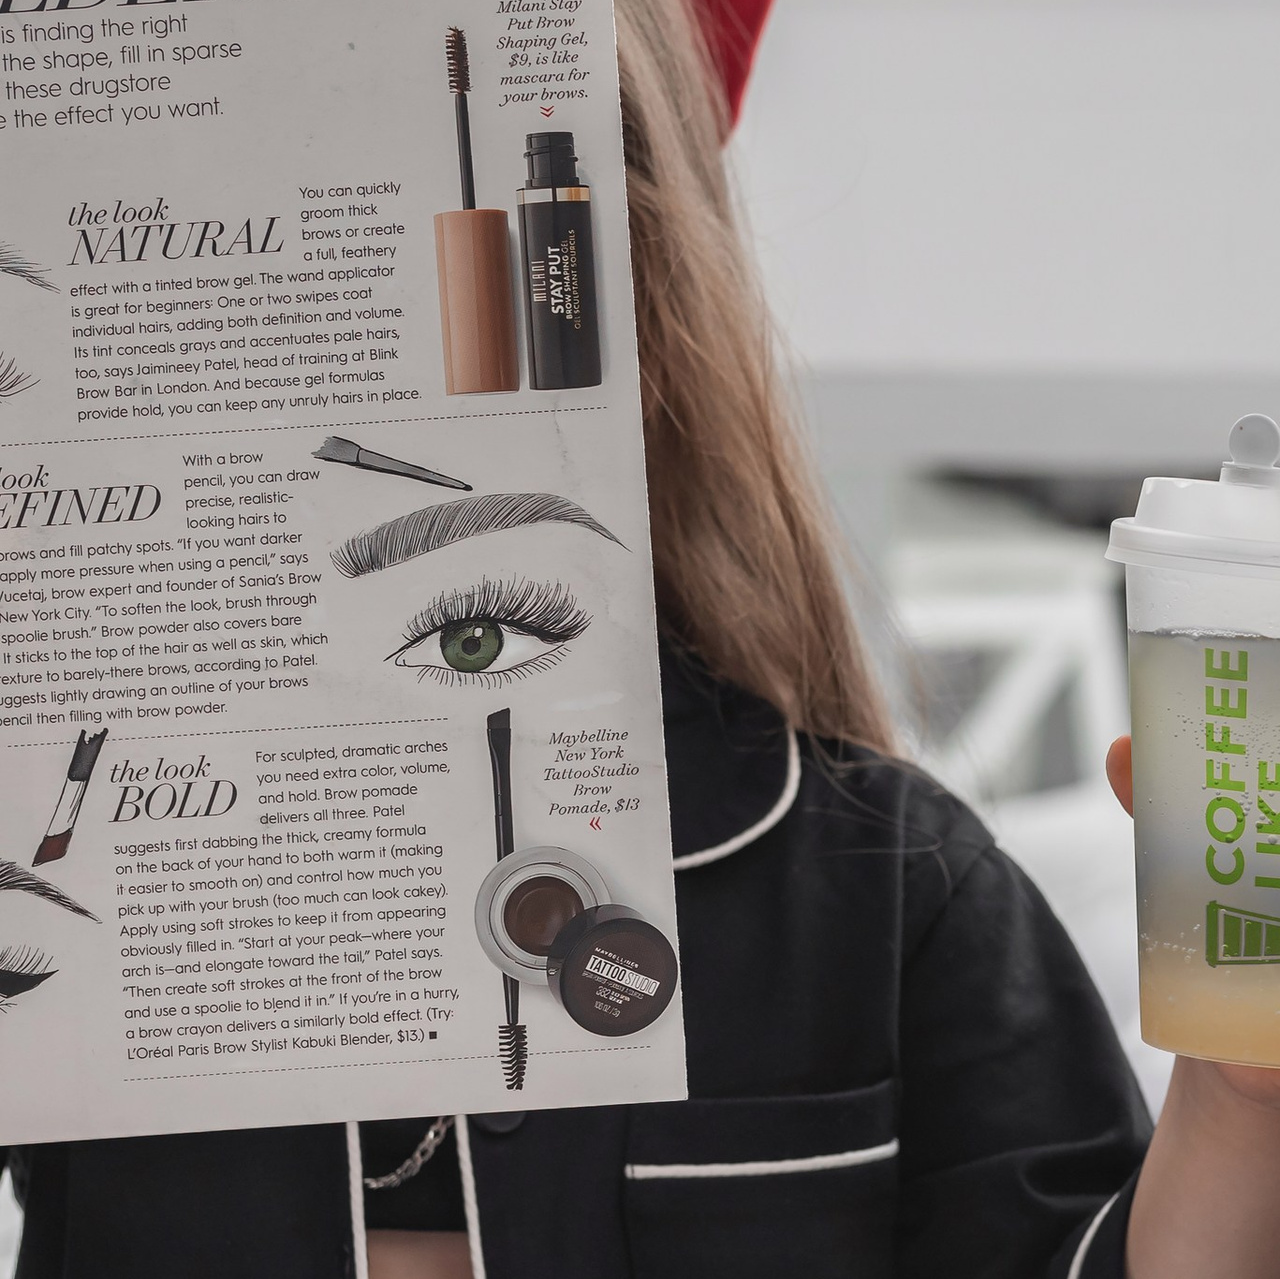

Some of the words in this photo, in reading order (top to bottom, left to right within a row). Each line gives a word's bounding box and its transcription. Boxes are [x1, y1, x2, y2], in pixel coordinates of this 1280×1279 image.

[0, 26, 15, 43] is
[22, 22, 93, 43] finding
[101, 18, 134, 37] the
[142, 13, 187, 38] right
[507, 18, 533, 30] Put
[536, 16, 574, 28] Brow
[496, 34, 556, 51] Shaping
[561, 31, 587, 46] Gel,
[2, 53, 35, 71] the
[43, 50, 112, 71] shape,
[120, 45, 139, 63] fill
[147, 45, 164, 61] in
[172, 43, 241, 64] sparse
[508, 53, 531, 67] $9,
[536, 52, 548, 64] is
[552, 50, 578, 63] like
[5, 81, 61, 99] these
[69, 73, 170, 98] drugstore
[500, 73, 564, 85] mascara
[568, 68, 589, 81] for
[498, 92, 537, 107] your
[540, 87, 587, 100] brows.
[14, 109, 47, 128] the
[54, 103, 113, 125] effect
[121, 105, 160, 125] you
[167, 96, 223, 117] want.
[299, 187, 323, 198] You
[328, 187, 352, 197] can
[356, 181, 400, 197] quickly
[68, 200, 107, 226] the
[113, 197, 169, 223] look
[300, 208, 344, 222] groom
[348, 203, 377, 216] thick
[67, 216, 285, 266] NATURAL
[302, 229, 341, 240] brows
[345, 228, 359, 237] or
[363, 223, 404, 236] create
[303, 252, 312, 261] a
[316, 247, 337, 260] full,
[341, 245, 396, 258] feathery
[547, 246, 561, 275] PUT
[70, 283, 107, 296] effect
[111, 281, 138, 293] with
[142, 283, 151, 292] a
[155, 277, 192, 291] tinted
[196, 277, 229, 288] brow
[233, 273, 256, 289] gel.
[259, 272, 283, 284] The
[286, 269, 323, 282] wand
[328, 265, 395, 282] applicator
[562, 255, 572, 292] SHAPING
[549, 278, 564, 314] STAY
[564, 294, 573, 320] BROW
[182, 454, 212, 466] With
[216, 456, 225, 464] a
[229, 452, 263, 464] brow
[184, 474, 225, 490] pencil,
[229, 475, 253, 487] you
[258, 473, 282, 483] can
[287, 469, 320, 481] draw
[185, 495, 234, 511] precise,
[187, 515, 234, 529] looking
[238, 513, 269, 525] hairs
[273, 512, 286, 523] to
[549, 728, 628, 747] Maybelline
[256, 751, 276, 762] For
[280, 746, 337, 762] sculpted,
[342, 743, 400, 757] dramatic
[404, 741, 448, 753] arches
[554, 749, 585, 762] New
[590, 745, 623, 760] York
[110, 759, 148, 784] the
[154, 755, 210, 780] look
[256, 774, 280, 786] you
[285, 768, 318, 781] need
[323, 767, 356, 779] extra
[360, 764, 396, 777] color,
[400, 762, 450, 774] volume,
[544, 763, 639, 780] TattooStudio
[1204, 647, 1249, 886] COFFEE
[573, 784, 611, 795] Brow
[108, 779, 238, 823] BOLD
[549, 800, 610, 815] Pomade,
[614, 798, 639, 812] $13
[589, 956, 627, 982] TATTOO
[625, 971, 658, 995] STUDIO
[127, 1045, 173, 1059] L’Oréal
[178, 1043, 209, 1056] Paris
[214, 1042, 246, 1054] Brow
[251, 1038, 287, 1053] Stylist
[292, 1035, 335, 1048] Kabuki
[340, 1032, 392, 1045] Blender,
[397, 1028, 424, 1043] $13.)
